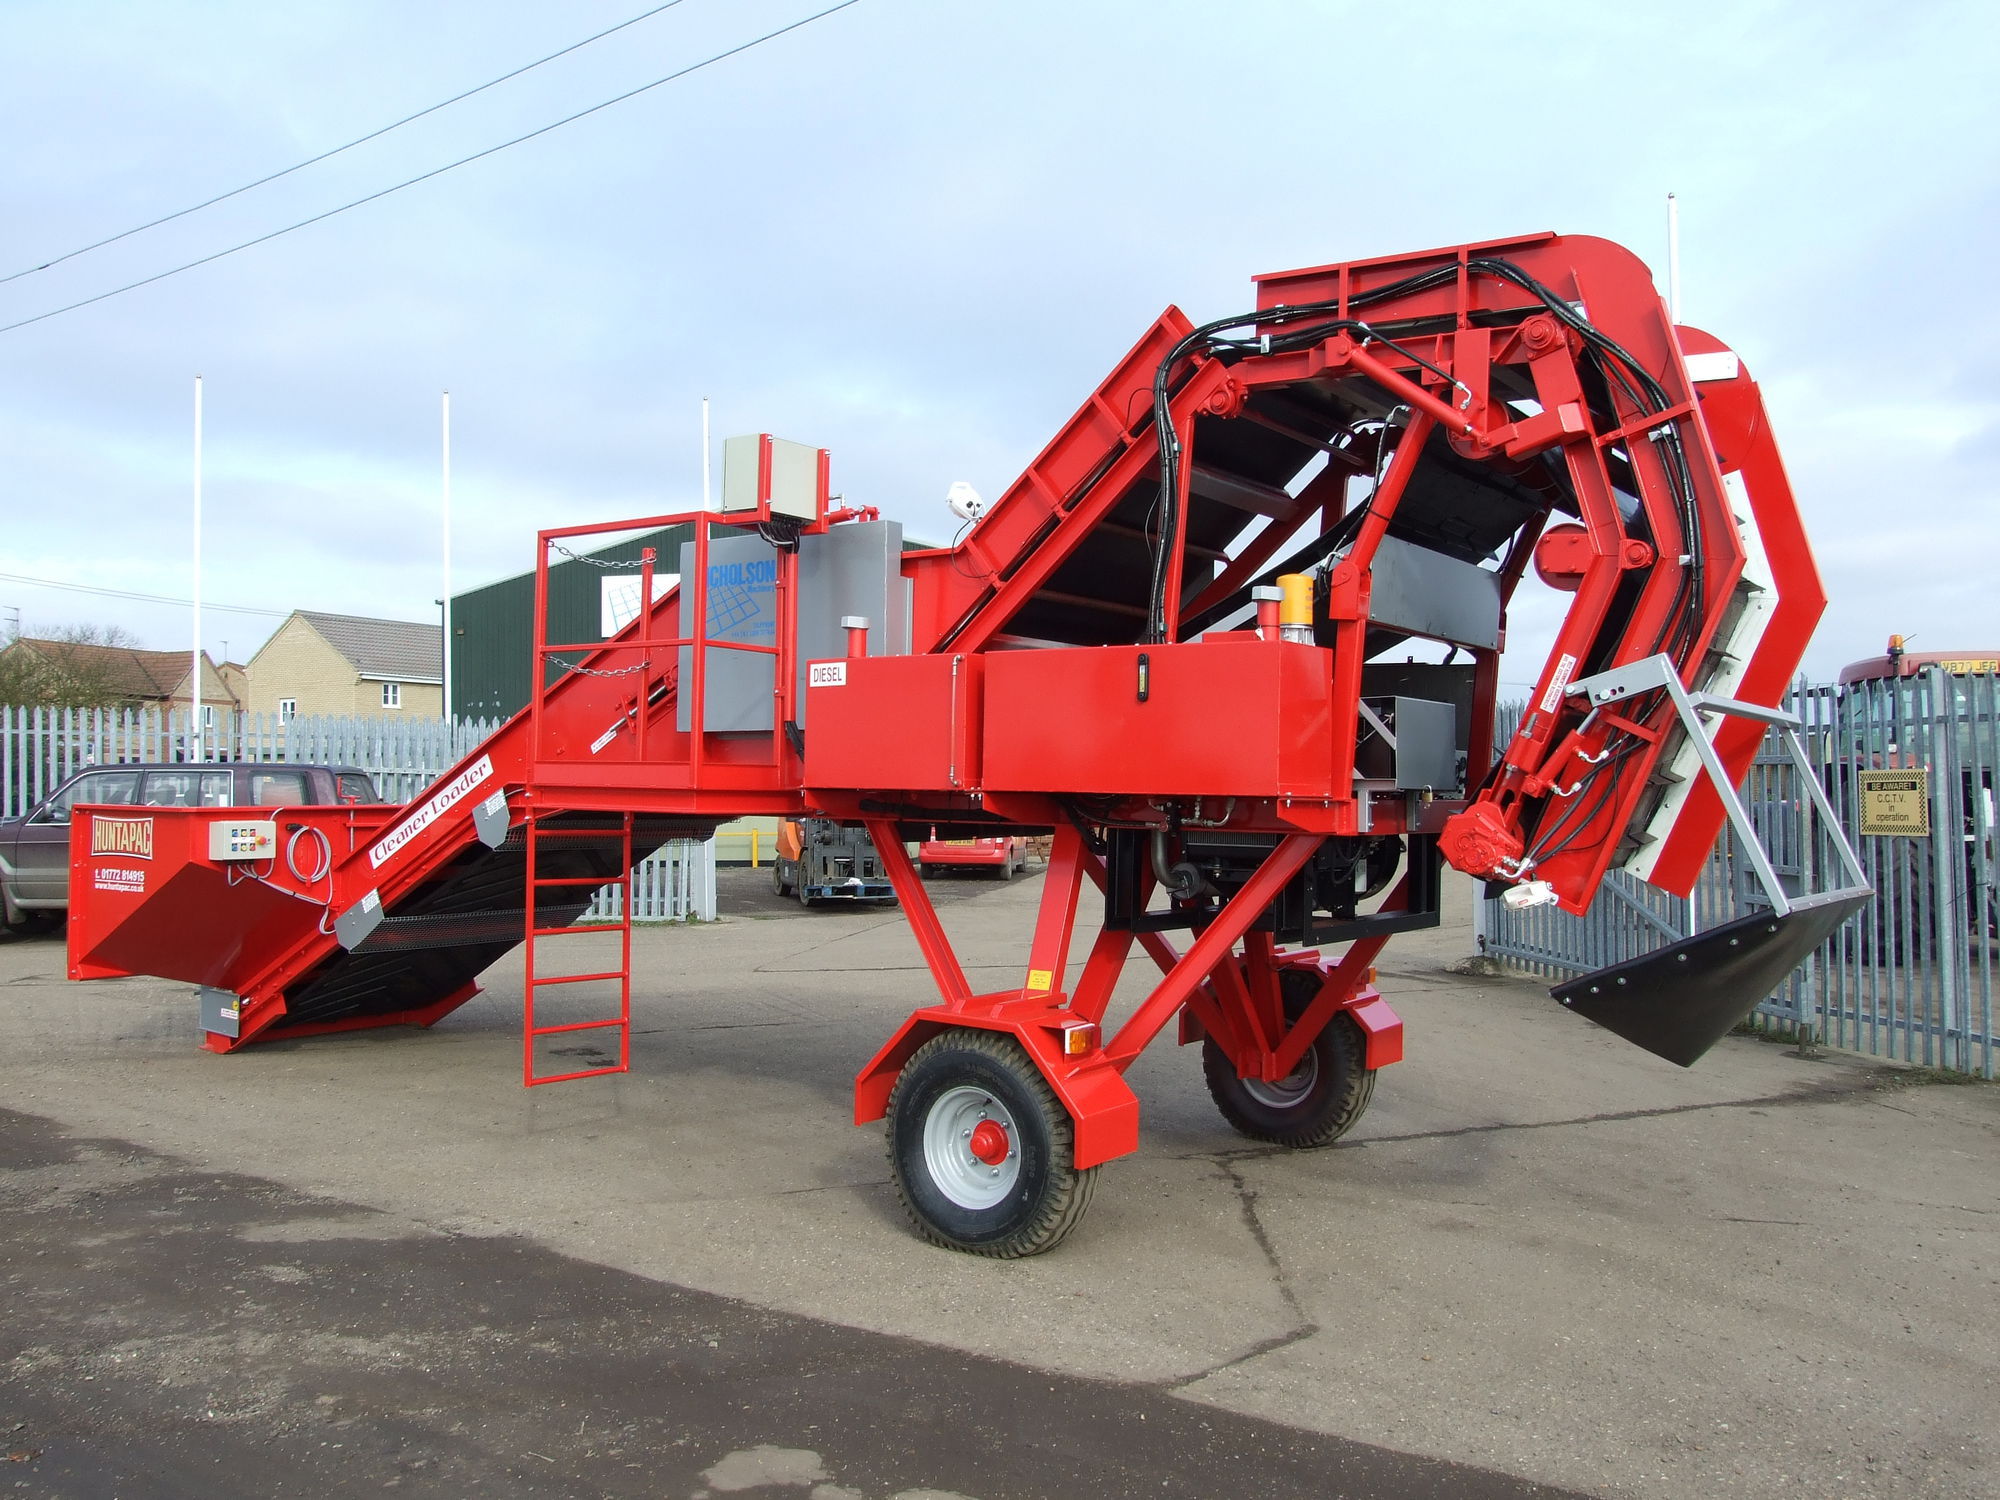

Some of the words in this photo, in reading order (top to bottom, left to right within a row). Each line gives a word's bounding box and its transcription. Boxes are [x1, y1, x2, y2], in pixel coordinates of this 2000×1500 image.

[814, 667, 842, 682] DIESEL
[1871, 782, 1882, 791] BE
[1882, 782, 1911, 791] AWARE!
[1877, 793, 1906, 803] C.C.T.V.
[374, 810, 429, 861] Cleaner
[431, 763, 486, 815] Loader
[1888, 804, 1895, 812] in
[1876, 813, 1909, 822] operation
[94, 820, 150, 853] HUNTAPAC
[101, 868, 121, 881] 01772
